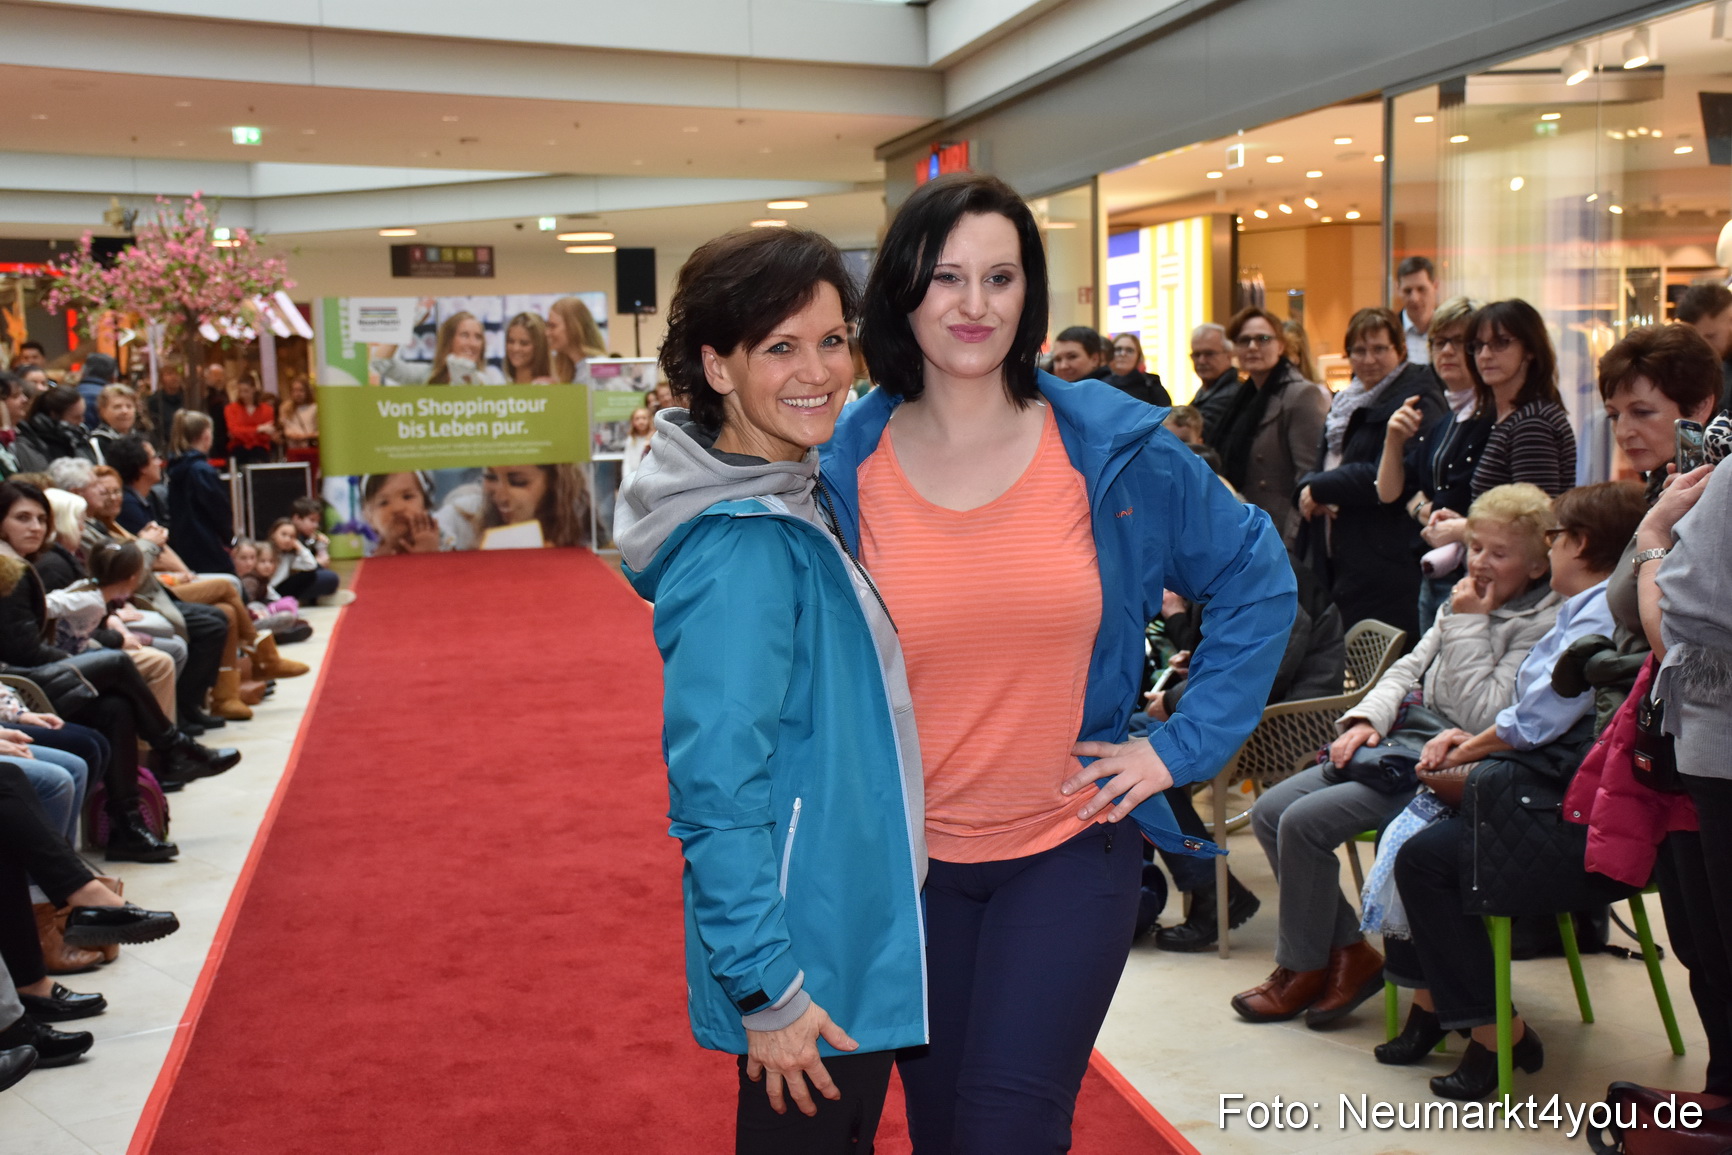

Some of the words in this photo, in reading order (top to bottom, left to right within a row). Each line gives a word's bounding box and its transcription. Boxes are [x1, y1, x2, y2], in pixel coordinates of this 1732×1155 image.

[377, 401, 414, 418] Von
[417, 397, 548, 419] Shoppingtour
[397, 420, 427, 439] bis
[430, 419, 489, 437] Leben
[492, 420, 529, 438] pur.
